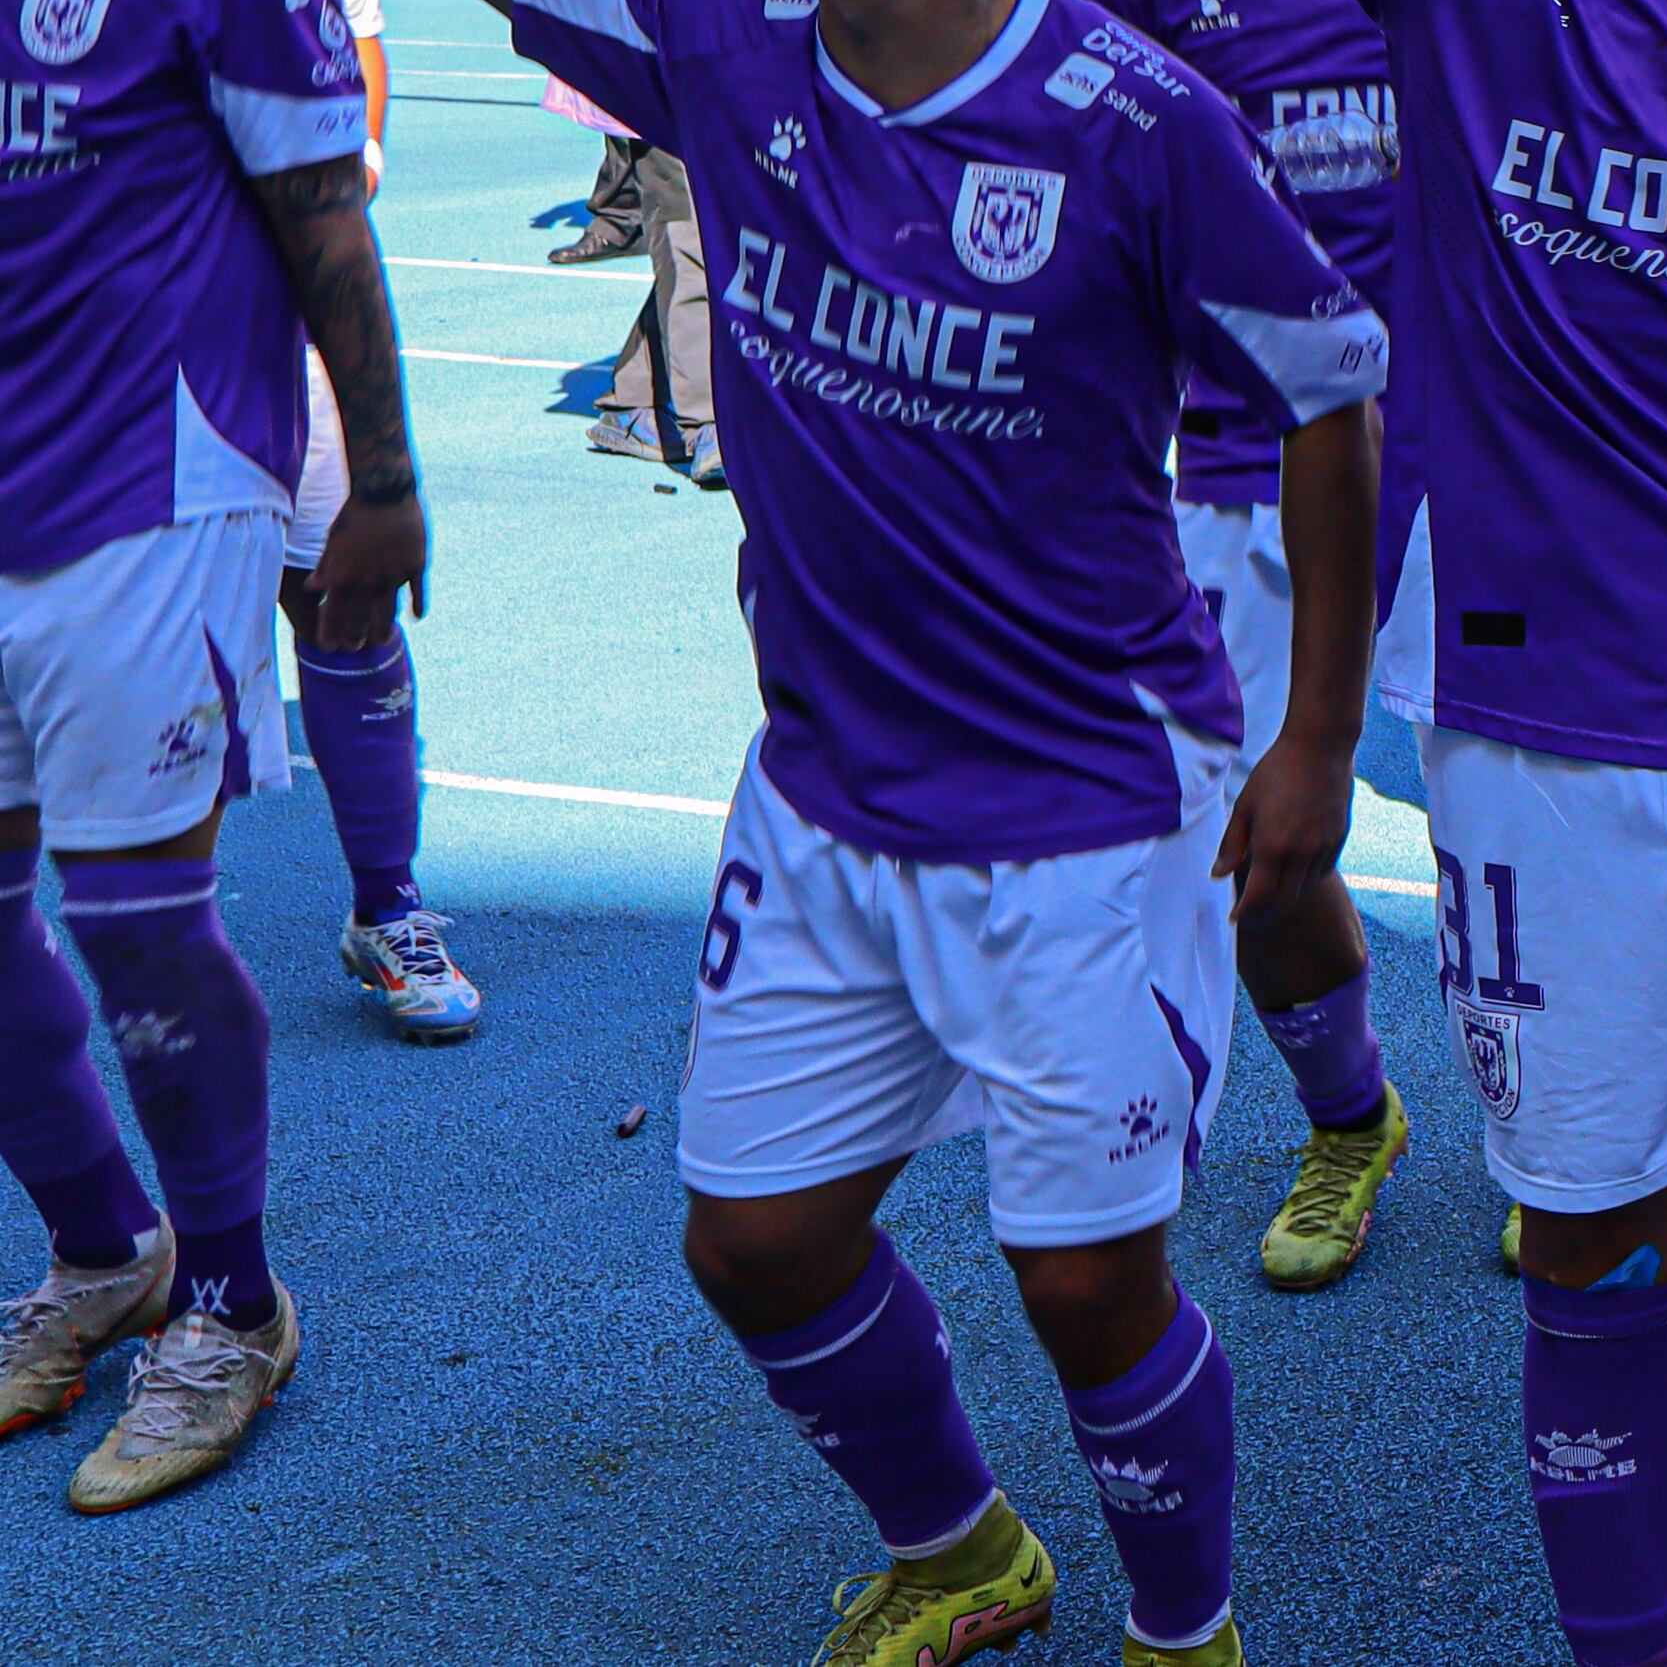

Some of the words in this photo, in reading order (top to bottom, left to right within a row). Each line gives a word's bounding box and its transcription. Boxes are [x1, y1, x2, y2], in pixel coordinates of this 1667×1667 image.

[1081, 27, 1139, 67] Del
[1133, 58, 1191, 99] Sur
[1102, 86, 1158, 132] salud
[1491, 119, 1574, 211] EL
[723, 226, 795, 332] EL
[810, 262, 1036, 395] CONCE
[701, 859, 764, 993] 6
[1432, 844, 1545, 1011] 31
